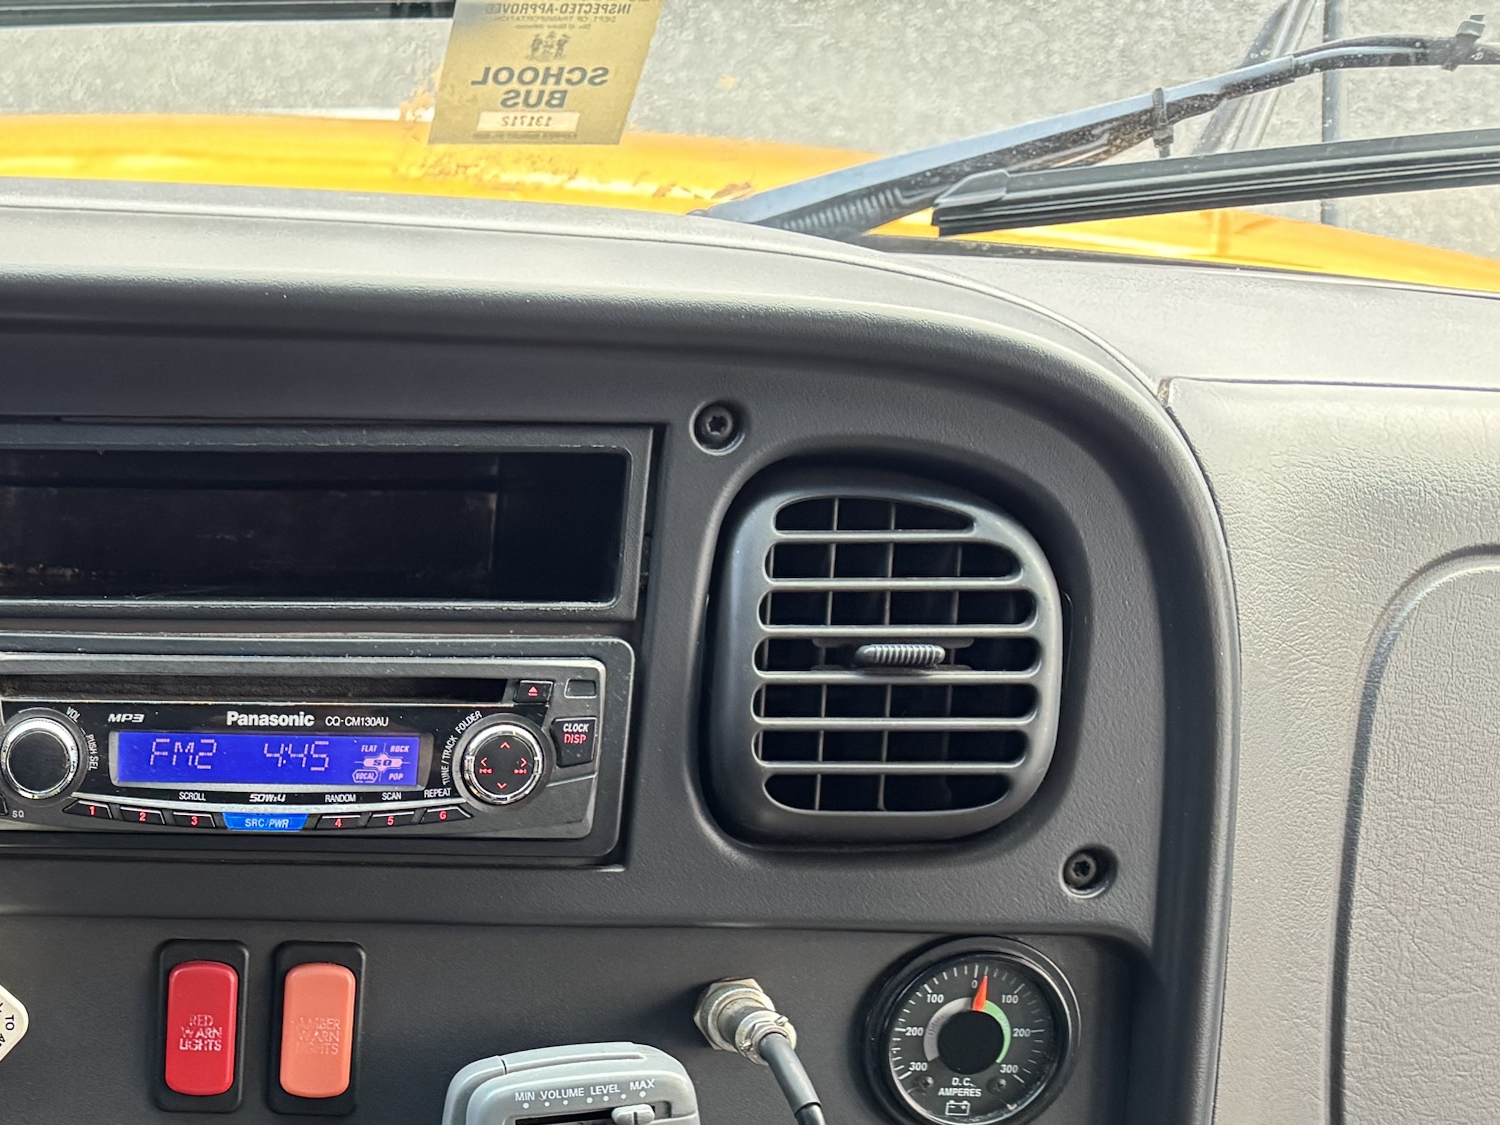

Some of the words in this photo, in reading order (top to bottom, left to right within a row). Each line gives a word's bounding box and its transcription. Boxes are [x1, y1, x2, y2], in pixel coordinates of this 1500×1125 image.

[66, 706, 82, 723] VOL
[108, 714, 145, 723] MP3
[226, 710, 315, 728] Panasonic
[325, 716, 389, 727] CQ-CM130AU
[455, 710, 483, 734] FOLDER
[562, 723, 589, 733] CLOCK
[563, 733, 587, 744] DISP
[361, 744, 378, 753] FLAT
[390, 745, 410, 753] ROCK
[150, 738, 217, 770] FM2
[263, 740, 330, 772] 4:45
[354, 771, 376, 781] VOCAL
[389, 772, 404, 781] POP
[179, 792, 206, 801] SCROLL
[325, 794, 356, 803] RANDOM
[382, 792, 401, 800] SCAN
[424, 788, 451, 798] REPEAT
[245, 818, 290, 828] SRC/PWR
[926, 994, 944, 1004] 100
[1001, 995, 1019, 1004] 100
[5, 1014, 15, 1031] TO
[181, 1027, 223, 1038] WARN
[905, 1027, 924, 1036] 200
[1012, 1028, 1031, 1037] 200
[179, 1039, 222, 1051] LIGHTS
[908, 1062, 928, 1071] 300
[1000, 1065, 1018, 1074] 300
[515, 1091, 535, 1101] MIN
[540, 1087, 585, 1100] VOLUME
[590, 1084, 621, 1095] LEVEL
[629, 1079, 655, 1091] MAX
[938, 1088, 982, 1097] AMPERES
